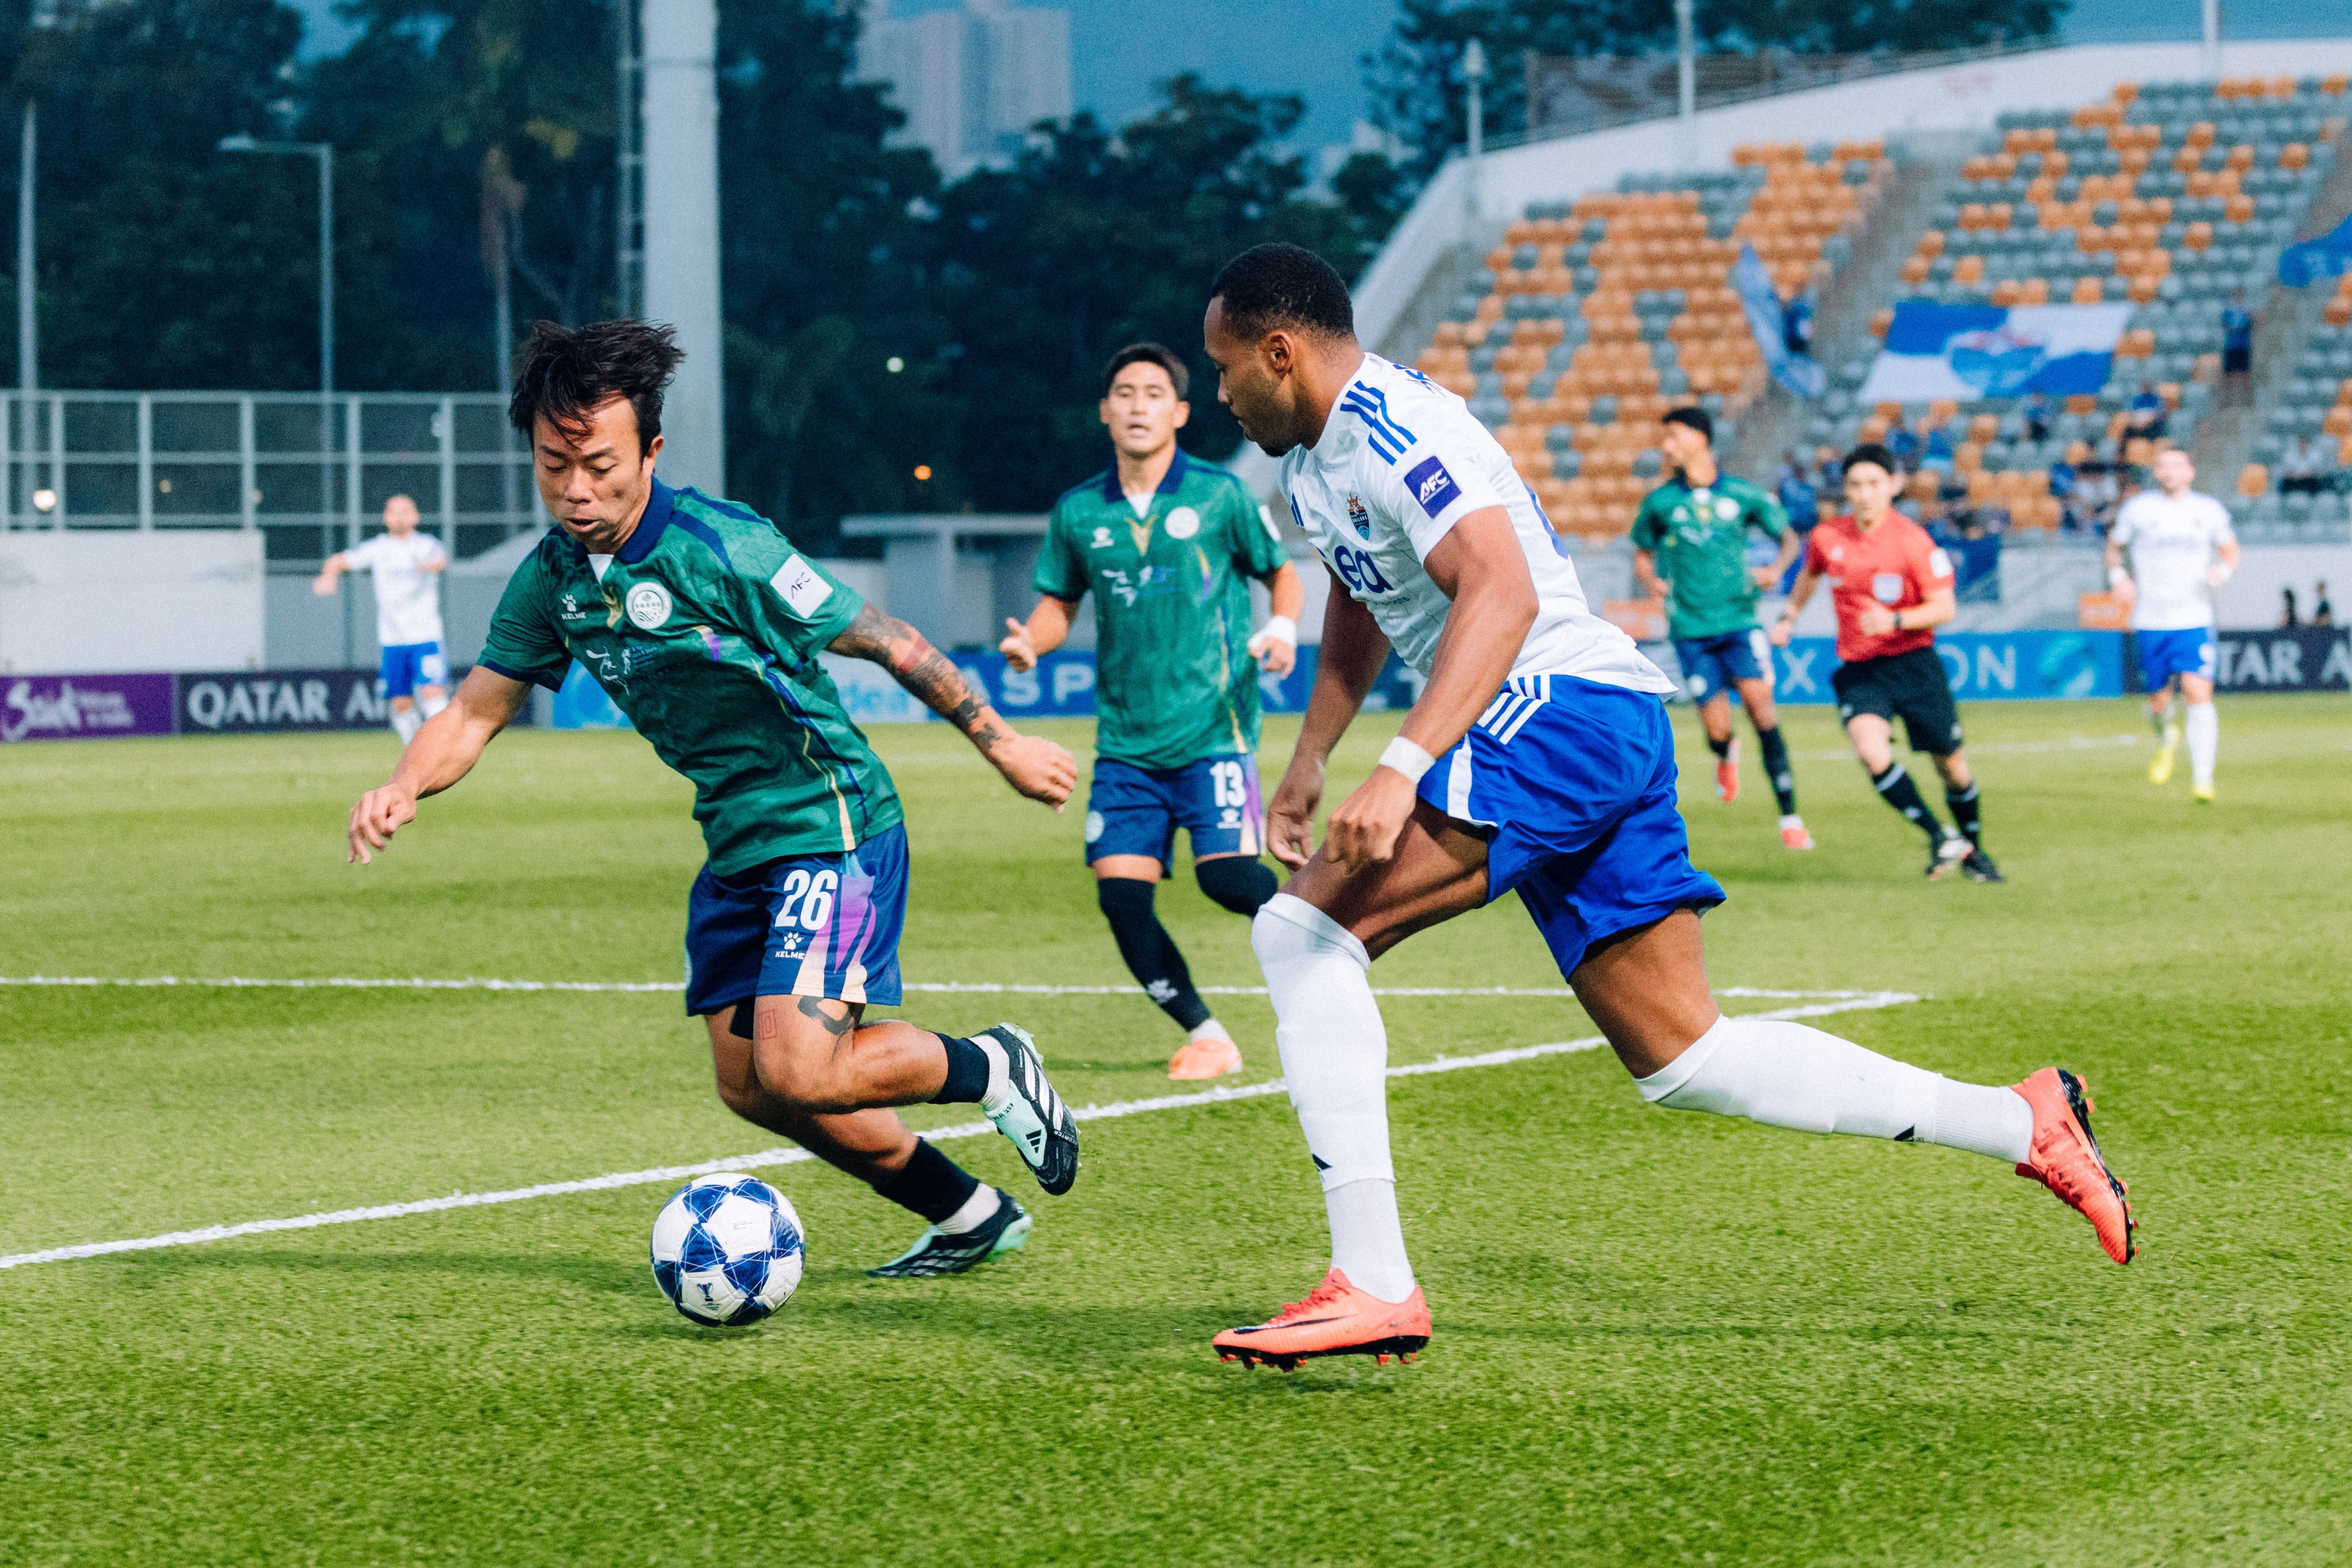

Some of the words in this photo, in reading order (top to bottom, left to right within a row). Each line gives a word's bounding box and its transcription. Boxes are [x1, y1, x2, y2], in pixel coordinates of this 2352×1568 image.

[1420, 468, 1447, 502] AFC
[791, 571, 811, 600] AFC
[561, 612, 586, 620] KELME
[187, 679, 331, 728] QATAR
[1208, 760, 1247, 808] 13
[774, 869, 839, 931] 26
[775, 950, 806, 960] KELME
